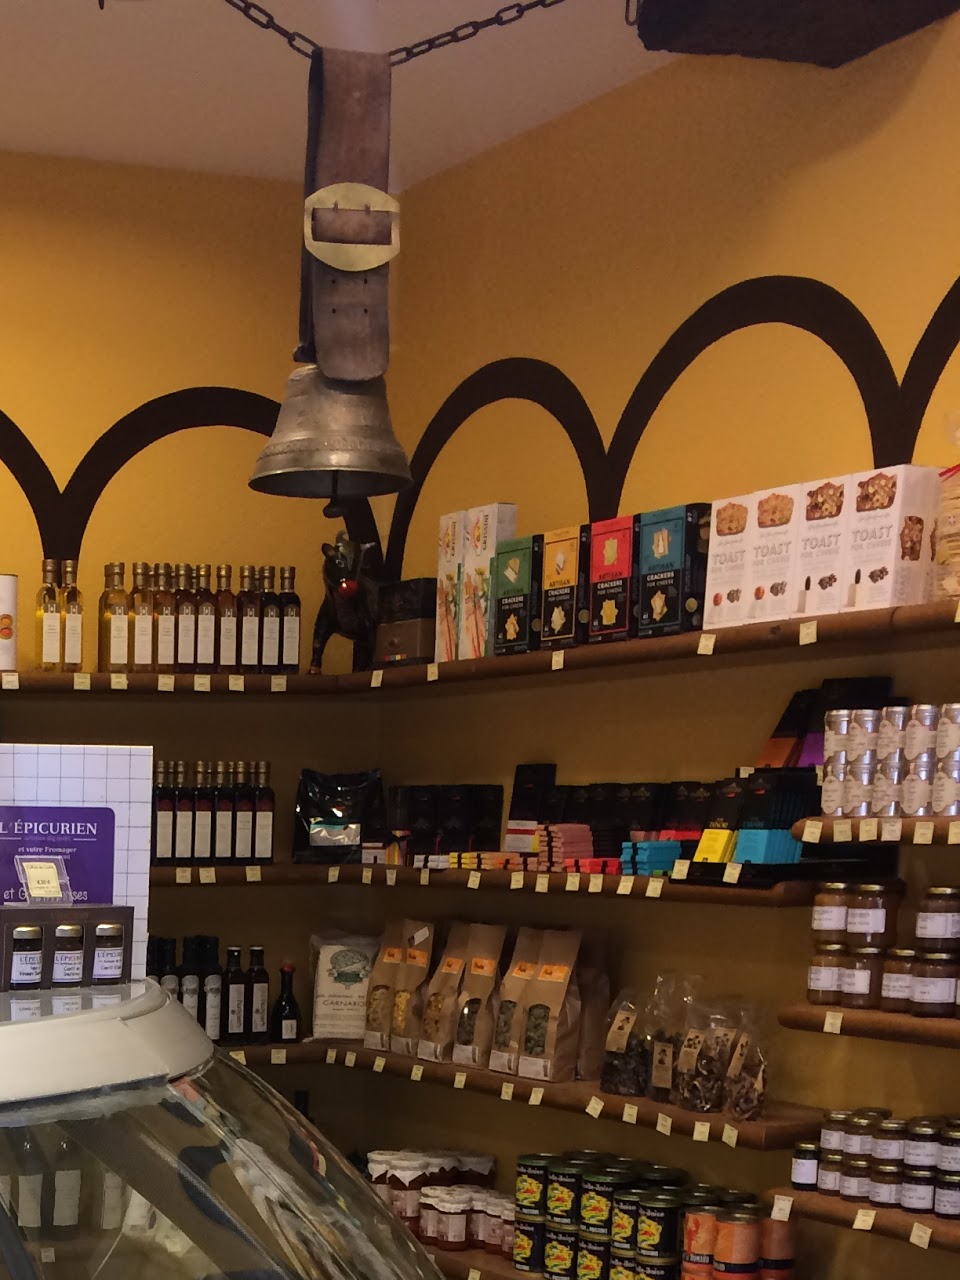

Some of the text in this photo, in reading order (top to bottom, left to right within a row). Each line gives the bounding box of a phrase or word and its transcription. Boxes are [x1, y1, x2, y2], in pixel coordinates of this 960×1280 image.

[801, 533, 842, 551] TOAST
[852, 524, 894, 543] TOAST
[712, 549, 746, 566] TOAST
[753, 541, 792, 559] TOAST
[322, 999, 366, 1007] CARNARO
